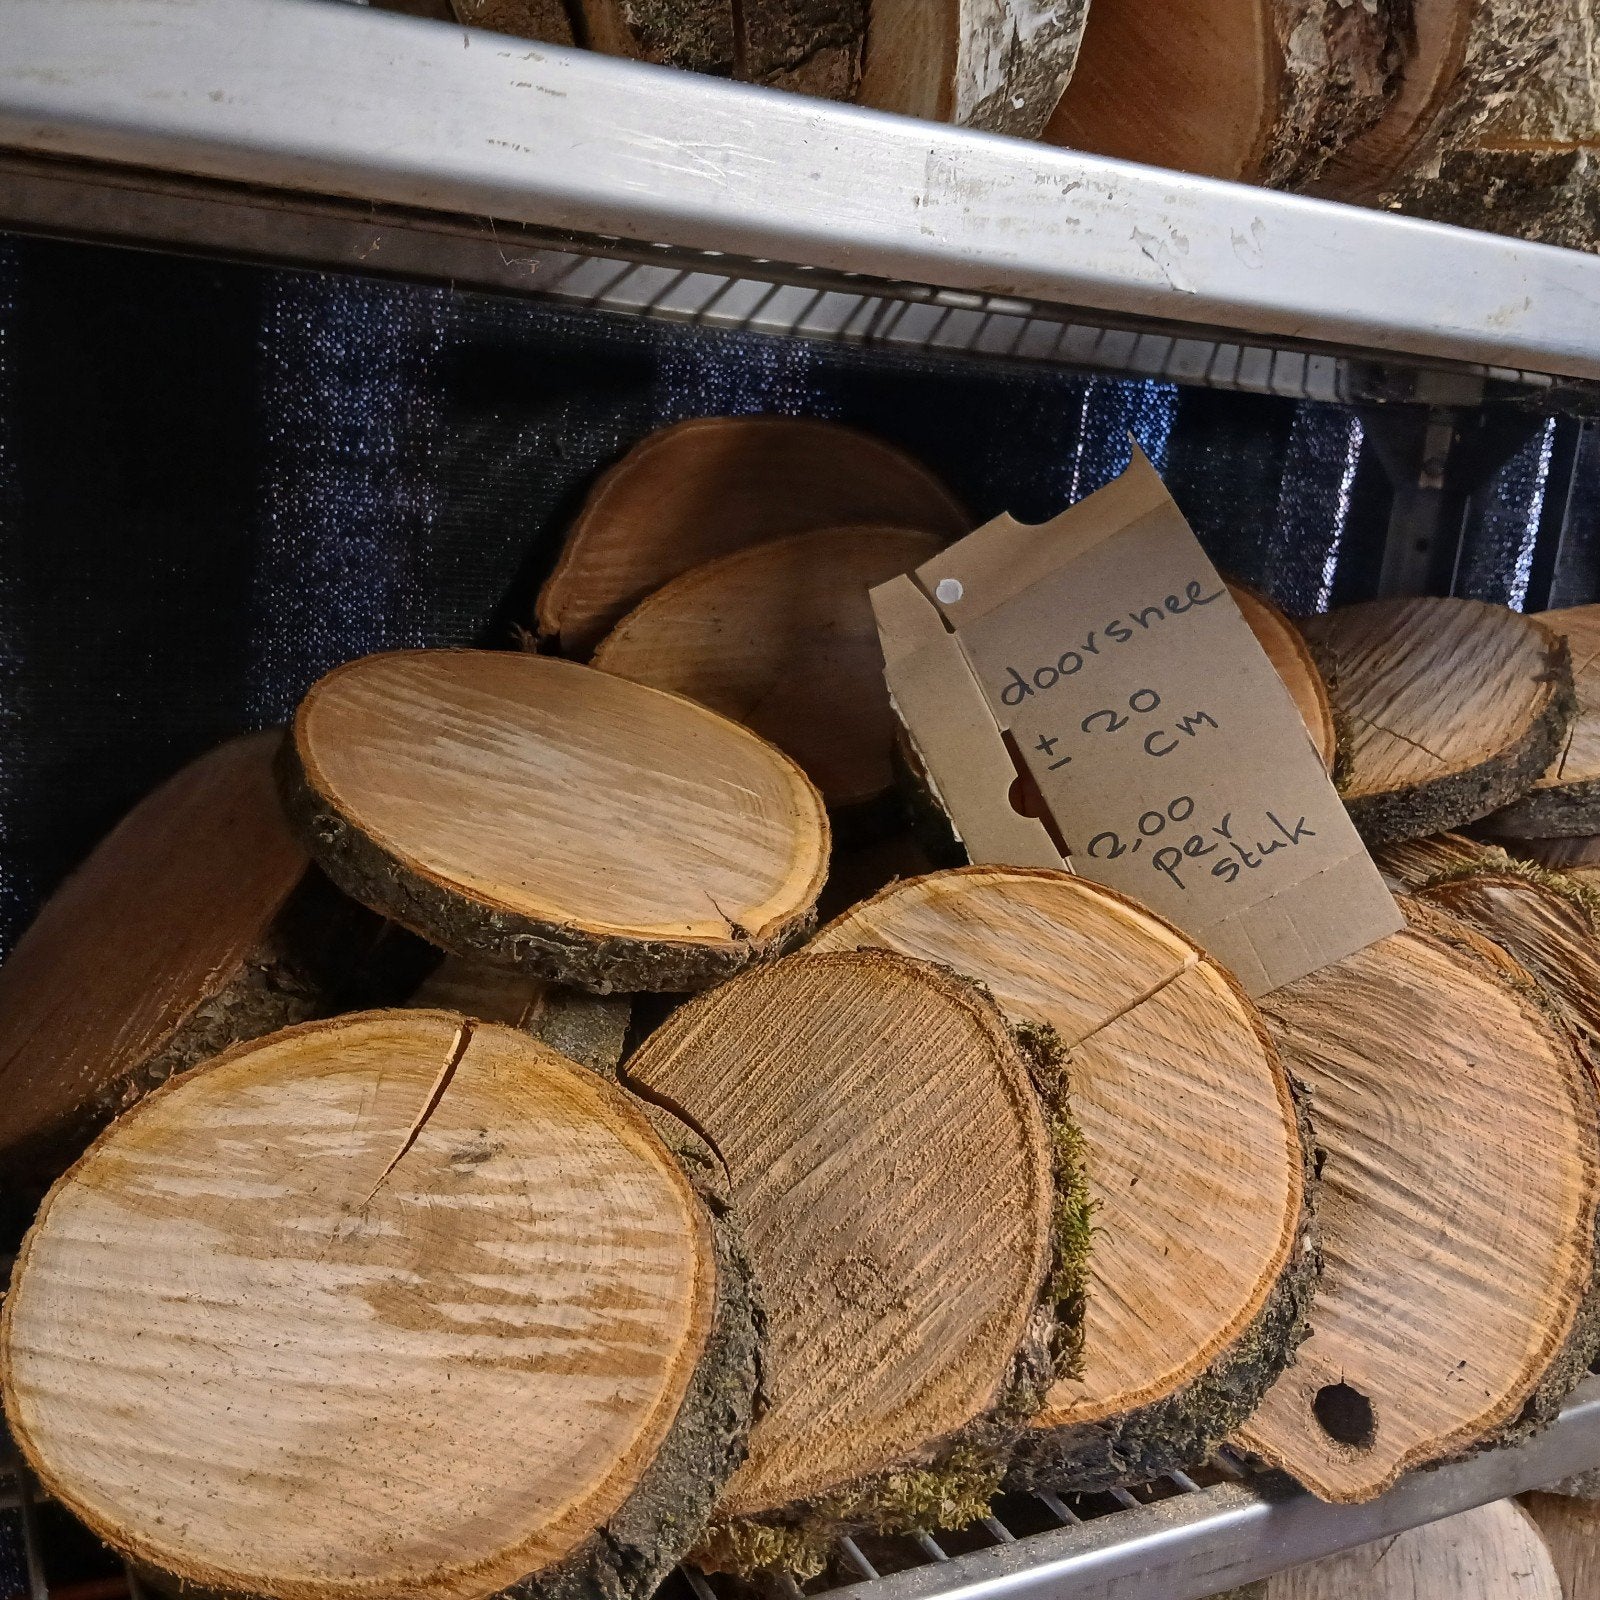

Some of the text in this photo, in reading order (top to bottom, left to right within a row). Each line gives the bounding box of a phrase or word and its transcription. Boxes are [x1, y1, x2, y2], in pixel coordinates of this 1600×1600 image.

[1001, 580, 1226, 705] doorsnee
[1081, 688, 1160, 733] 20
[1087, 796, 1195, 860] 2,00
[1152, 812, 1232, 890] per
[1211, 811, 1316, 883] stuk
